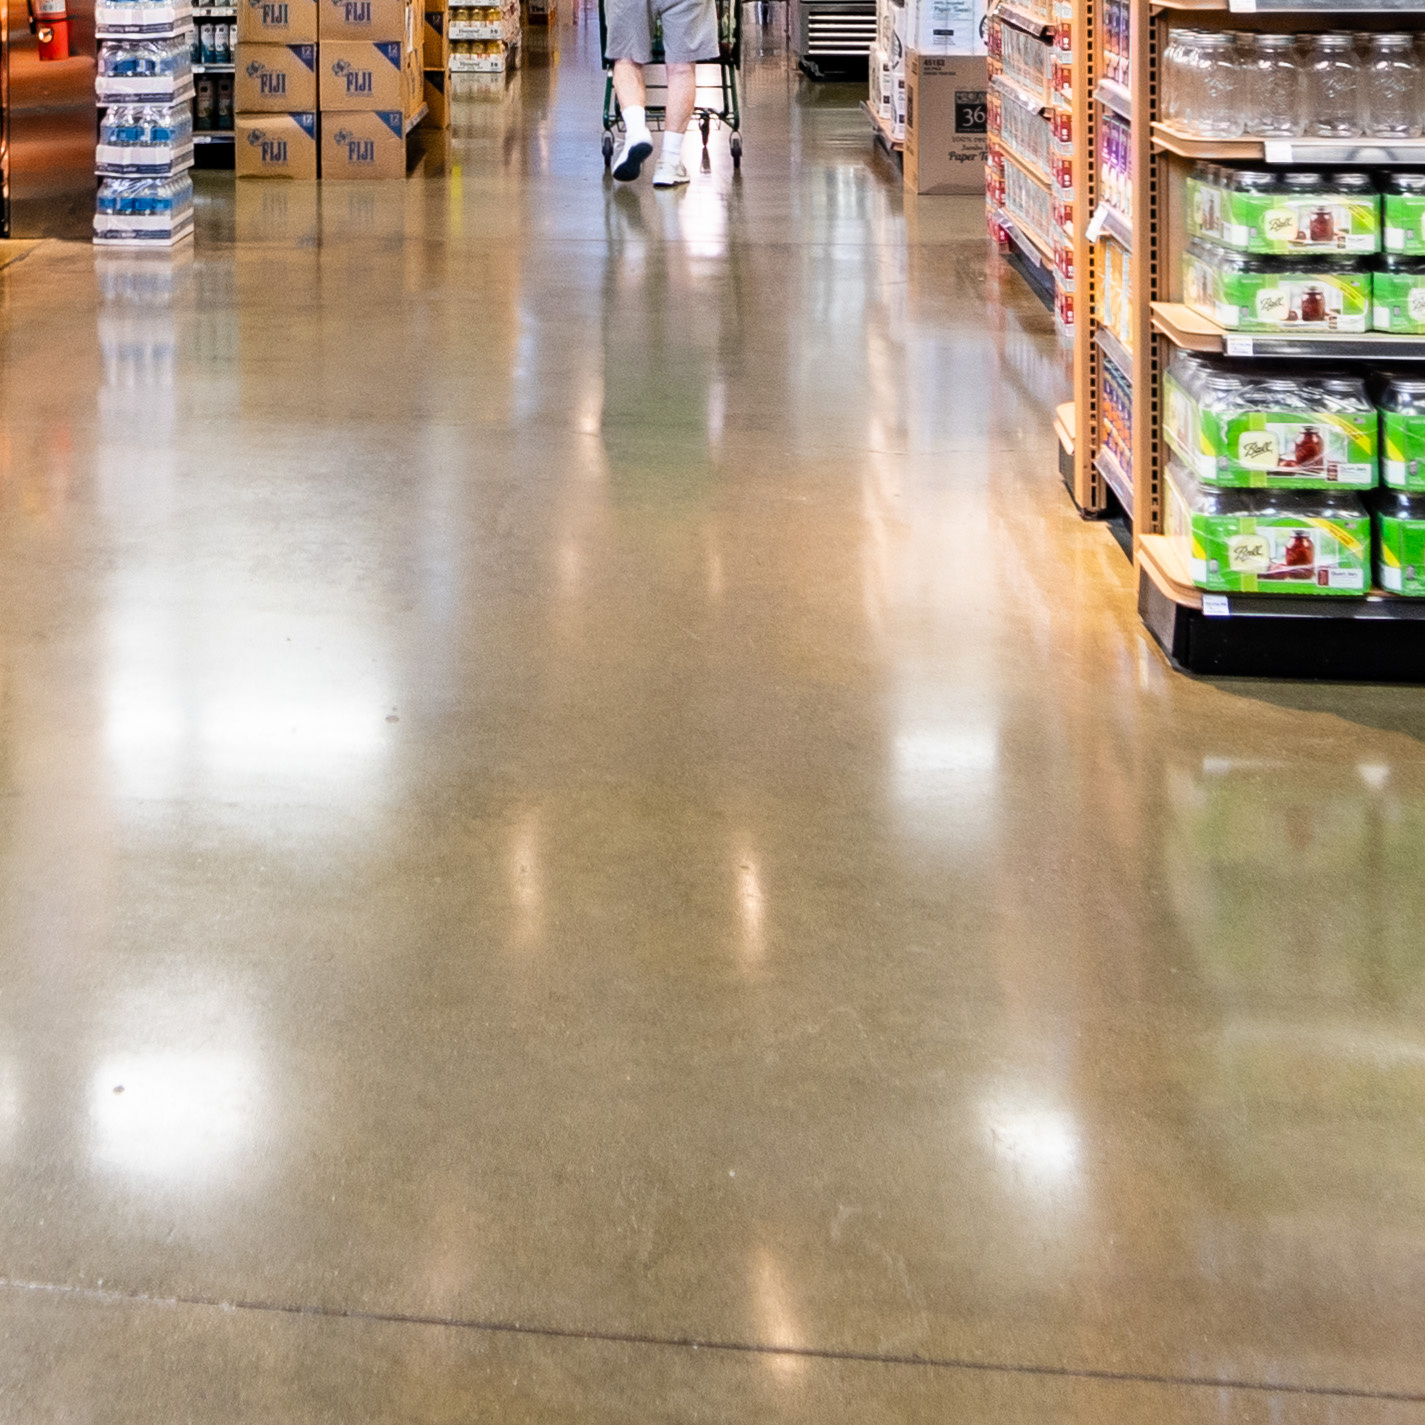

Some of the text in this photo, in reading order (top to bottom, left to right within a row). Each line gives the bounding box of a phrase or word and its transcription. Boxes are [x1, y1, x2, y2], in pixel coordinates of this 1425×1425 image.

[263, 3, 288, 24] FIJI
[345, 2, 371, 22] FIJI
[301, 46, 311, 55] 12
[388, 45, 397, 53] 12
[260, 73, 286, 93] FIJI
[346, 72, 372, 92] FIJI
[303, 115, 313, 124] 12
[390, 114, 399, 122] 12
[962, 106, 986, 126] 36
[262, 141, 287, 161] FIJI
[348, 140, 374, 161] FIJI
[948, 151, 977, 163] Paper
[1269, 218, 1293, 232] Ball
[1260, 297, 1283, 311] Ball
[1243, 442, 1272, 457] Ball
[1233, 545, 1262, 560] Ball
